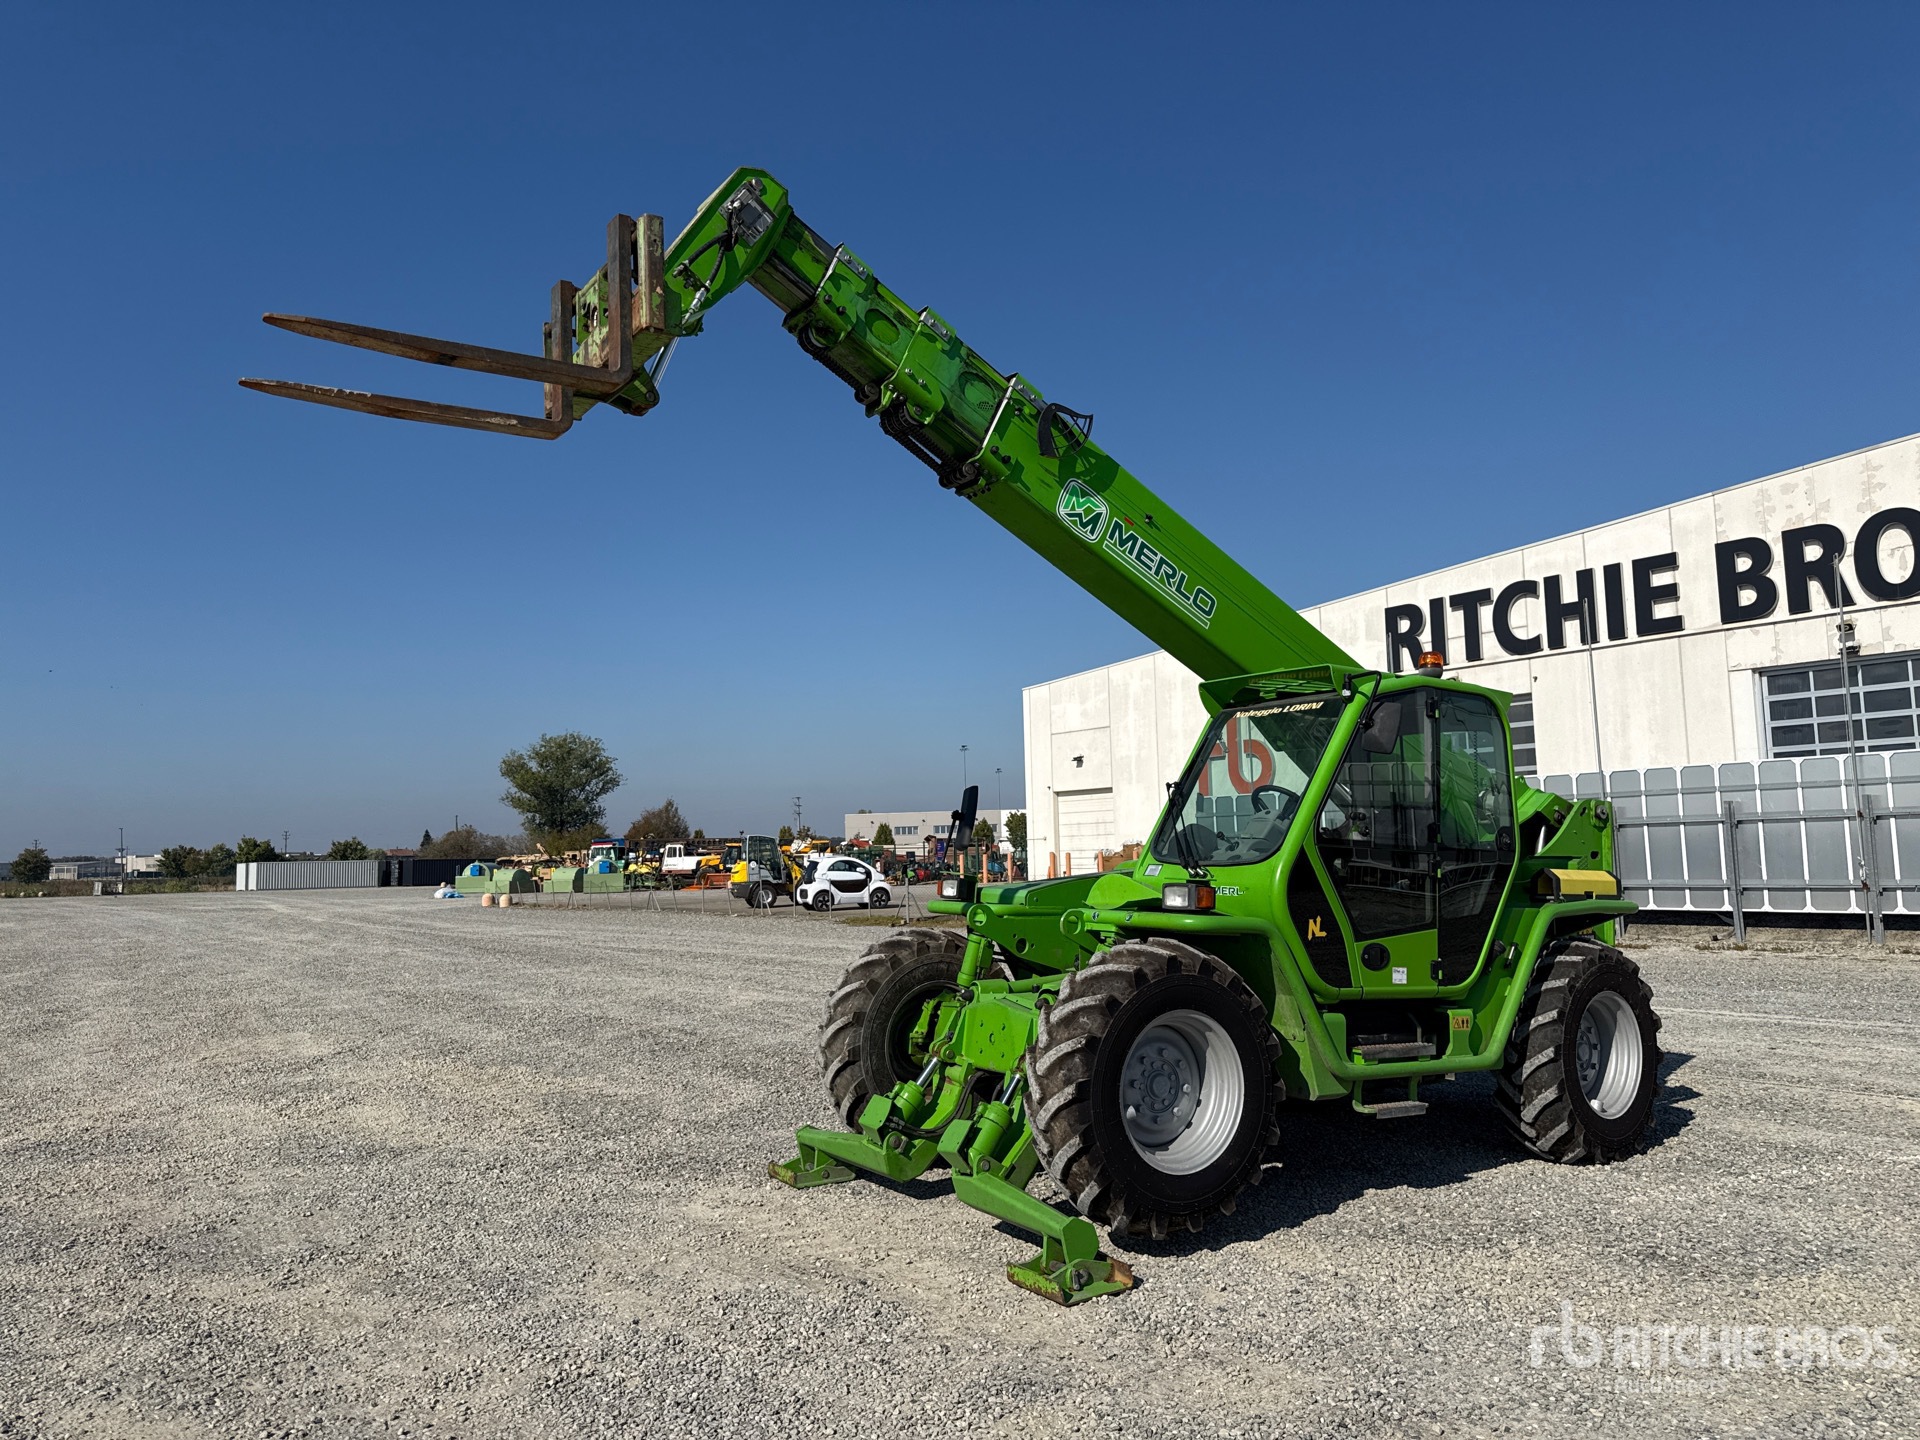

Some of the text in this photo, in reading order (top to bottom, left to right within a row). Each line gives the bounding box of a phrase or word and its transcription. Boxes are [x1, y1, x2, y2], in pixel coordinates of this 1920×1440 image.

[1107, 517, 1217, 618] MERLO
[1384, 507, 1920, 673] RITCHIE BRO
[1233, 707, 1283, 719] Noleggio
